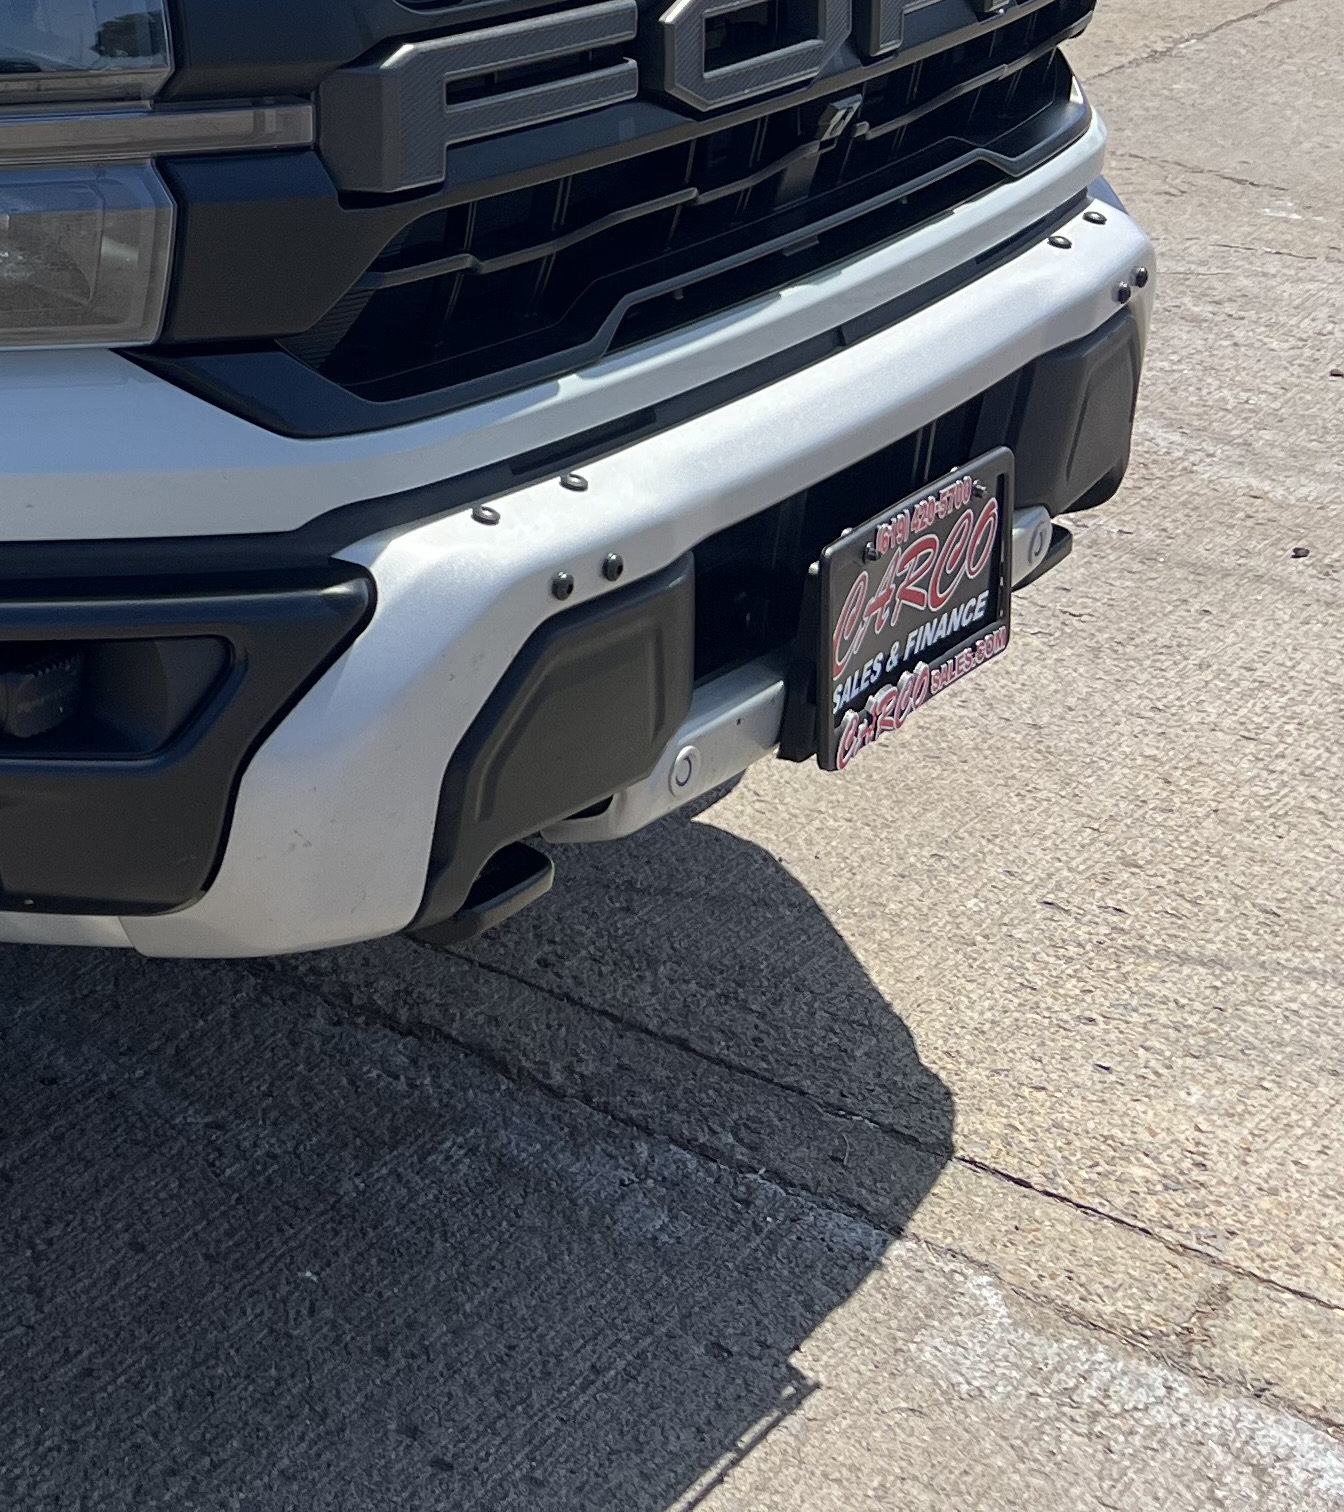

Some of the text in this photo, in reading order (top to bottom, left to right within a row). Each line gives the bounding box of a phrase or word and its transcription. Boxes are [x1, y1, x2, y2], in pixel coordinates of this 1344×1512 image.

[875, 476, 973, 554] (619) 420-5700
[833, 497, 1000, 680] CARCO
[832, 590, 990, 715] SALES & FINANCE
